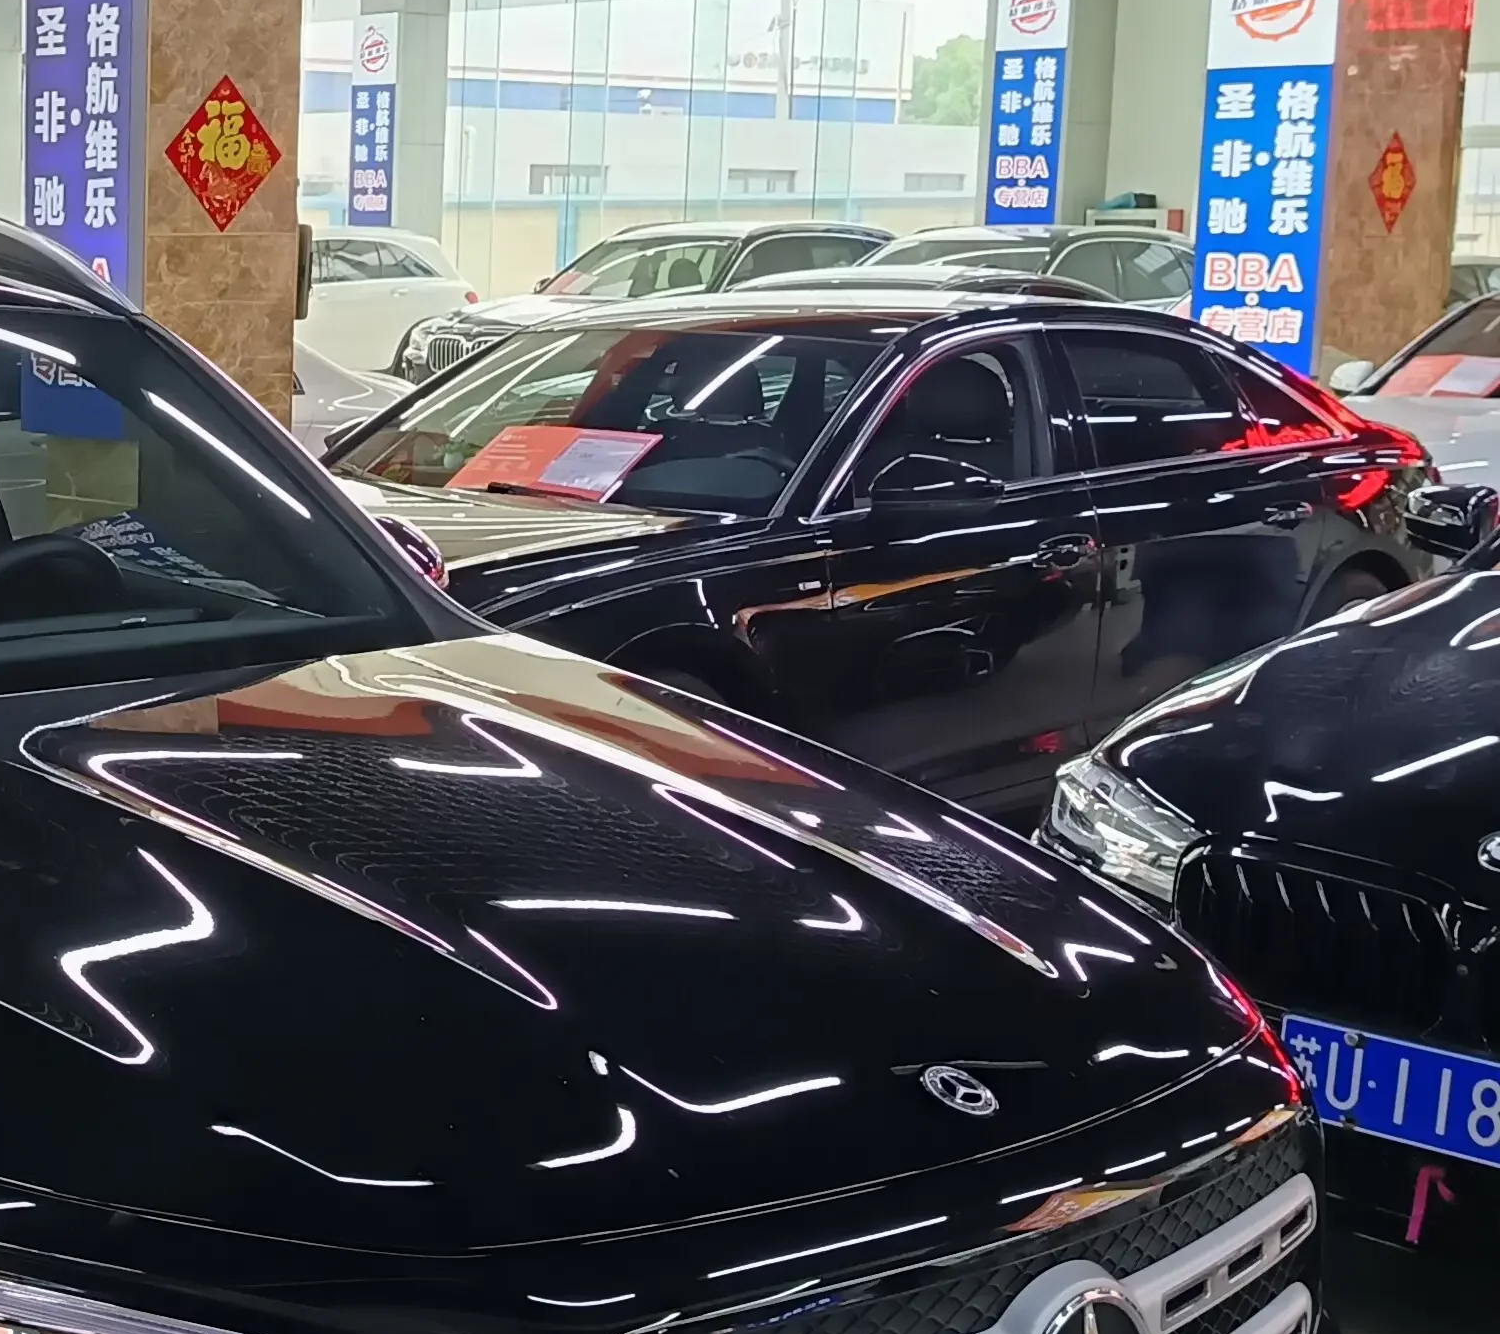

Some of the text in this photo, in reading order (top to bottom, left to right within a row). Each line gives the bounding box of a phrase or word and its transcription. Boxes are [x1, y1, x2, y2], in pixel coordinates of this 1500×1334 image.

[33, 4, 69, 228] 圣非驰
[82, 2, 122, 232] 格航维乐
[197, 100, 251, 171] 福
[353, 169, 388, 188] BBA
[995, 155, 1049, 180] BBA
[1207, 82, 1256, 235] 圣非驰
[1268, 81, 1320, 236] 格航维乐
[1203, 251, 1304, 293] BBA
[1199, 305, 1304, 344] 专营店
